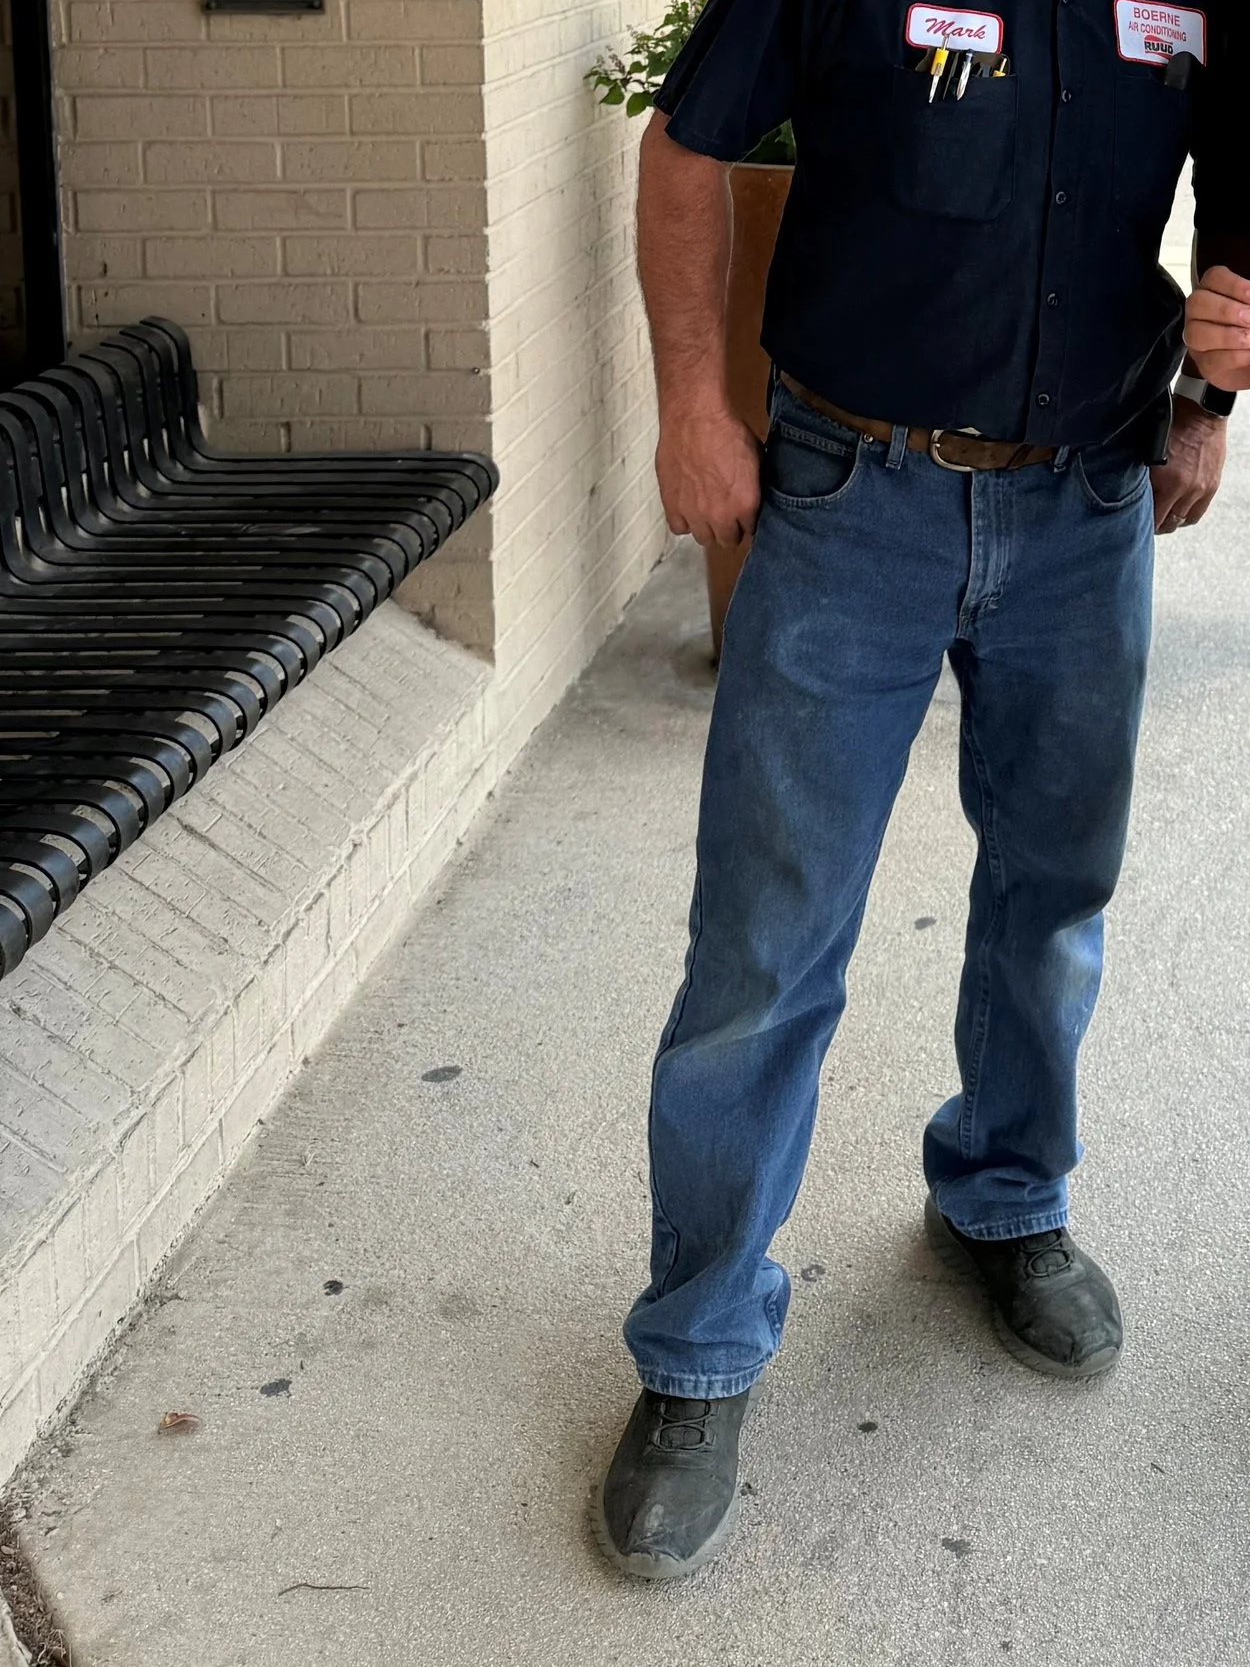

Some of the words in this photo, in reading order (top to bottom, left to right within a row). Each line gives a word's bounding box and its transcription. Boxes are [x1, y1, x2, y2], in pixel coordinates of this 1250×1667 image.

[1133, 6, 1181, 27] BOERNE
[925, 17, 987, 40] Mark
[1128, 20, 1139, 32] AIR
[1140, 23, 1187, 42] CONDITIONING
[1144, 40, 1174, 55] RUUD
